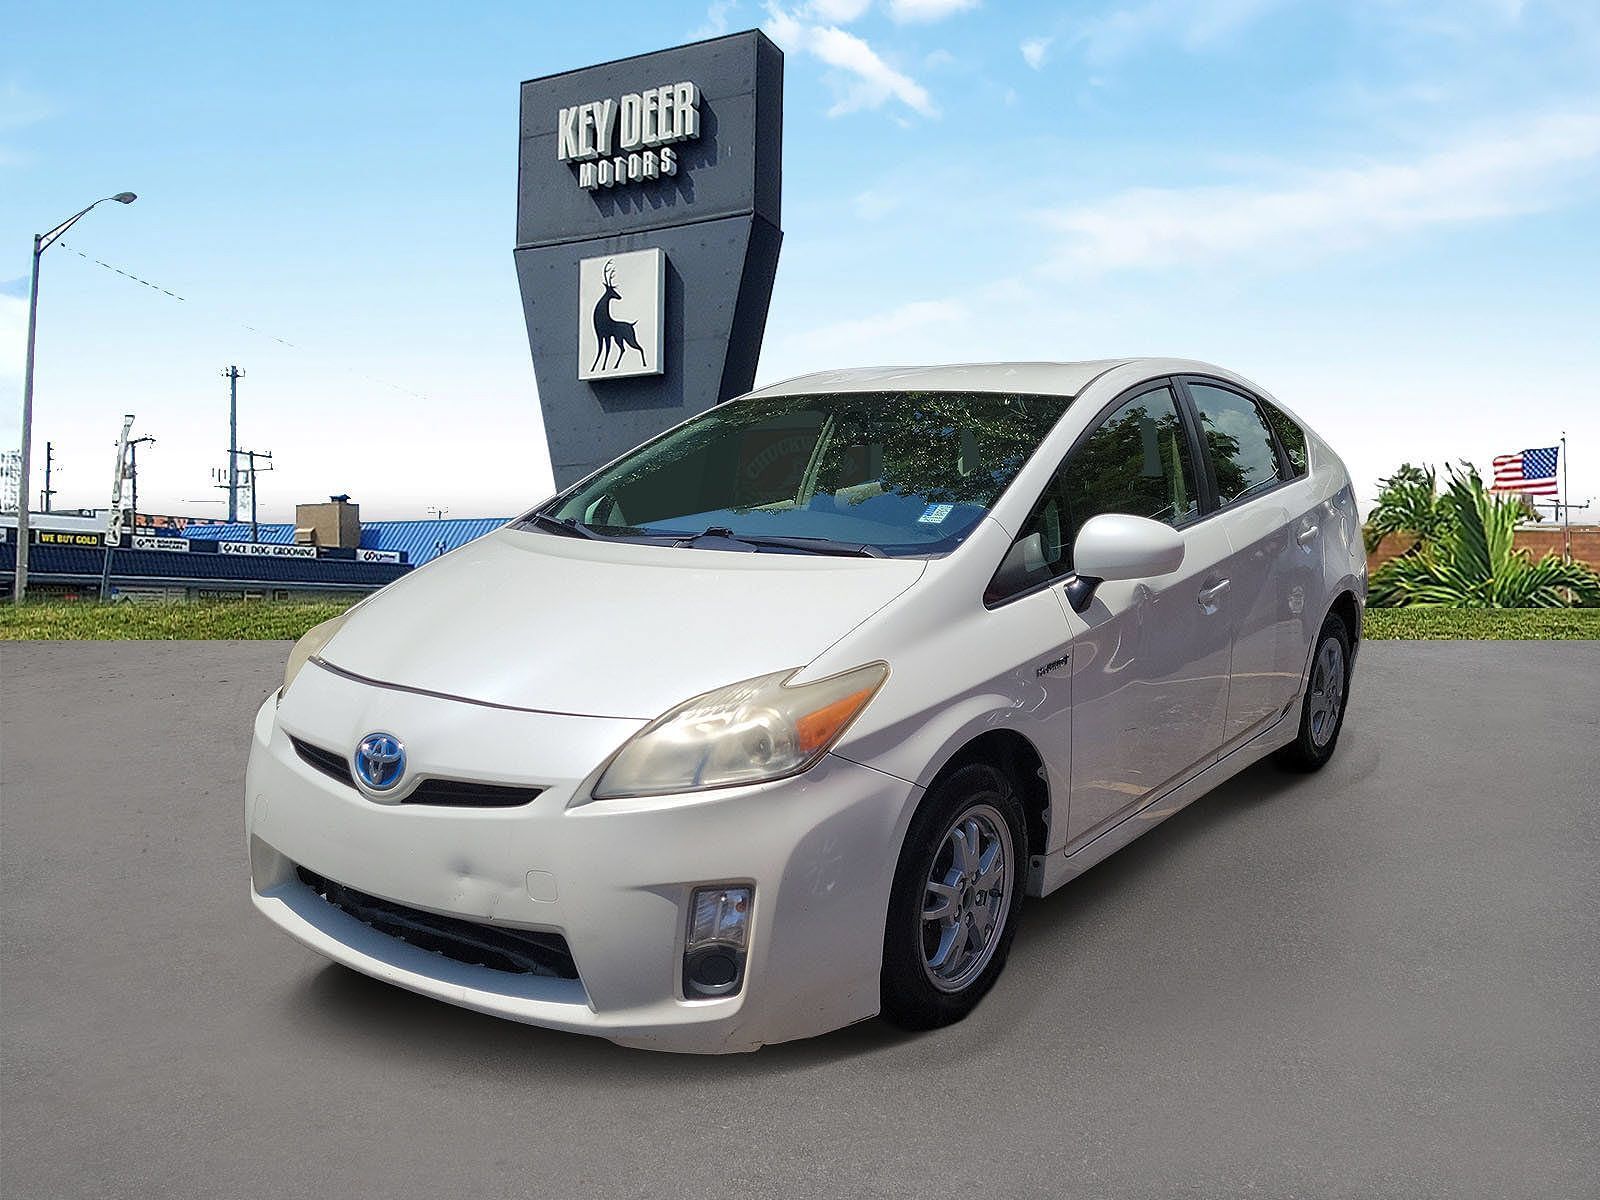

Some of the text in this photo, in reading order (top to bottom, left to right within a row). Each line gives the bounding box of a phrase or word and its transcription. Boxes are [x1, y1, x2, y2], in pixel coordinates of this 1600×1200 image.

[558, 81, 700, 161] KEY DEER
[579, 147, 677, 190] MOTORS
[41, 533, 98, 545] WE BUY GOLD
[233, 545, 315, 557] ACE DOG GROOMING
